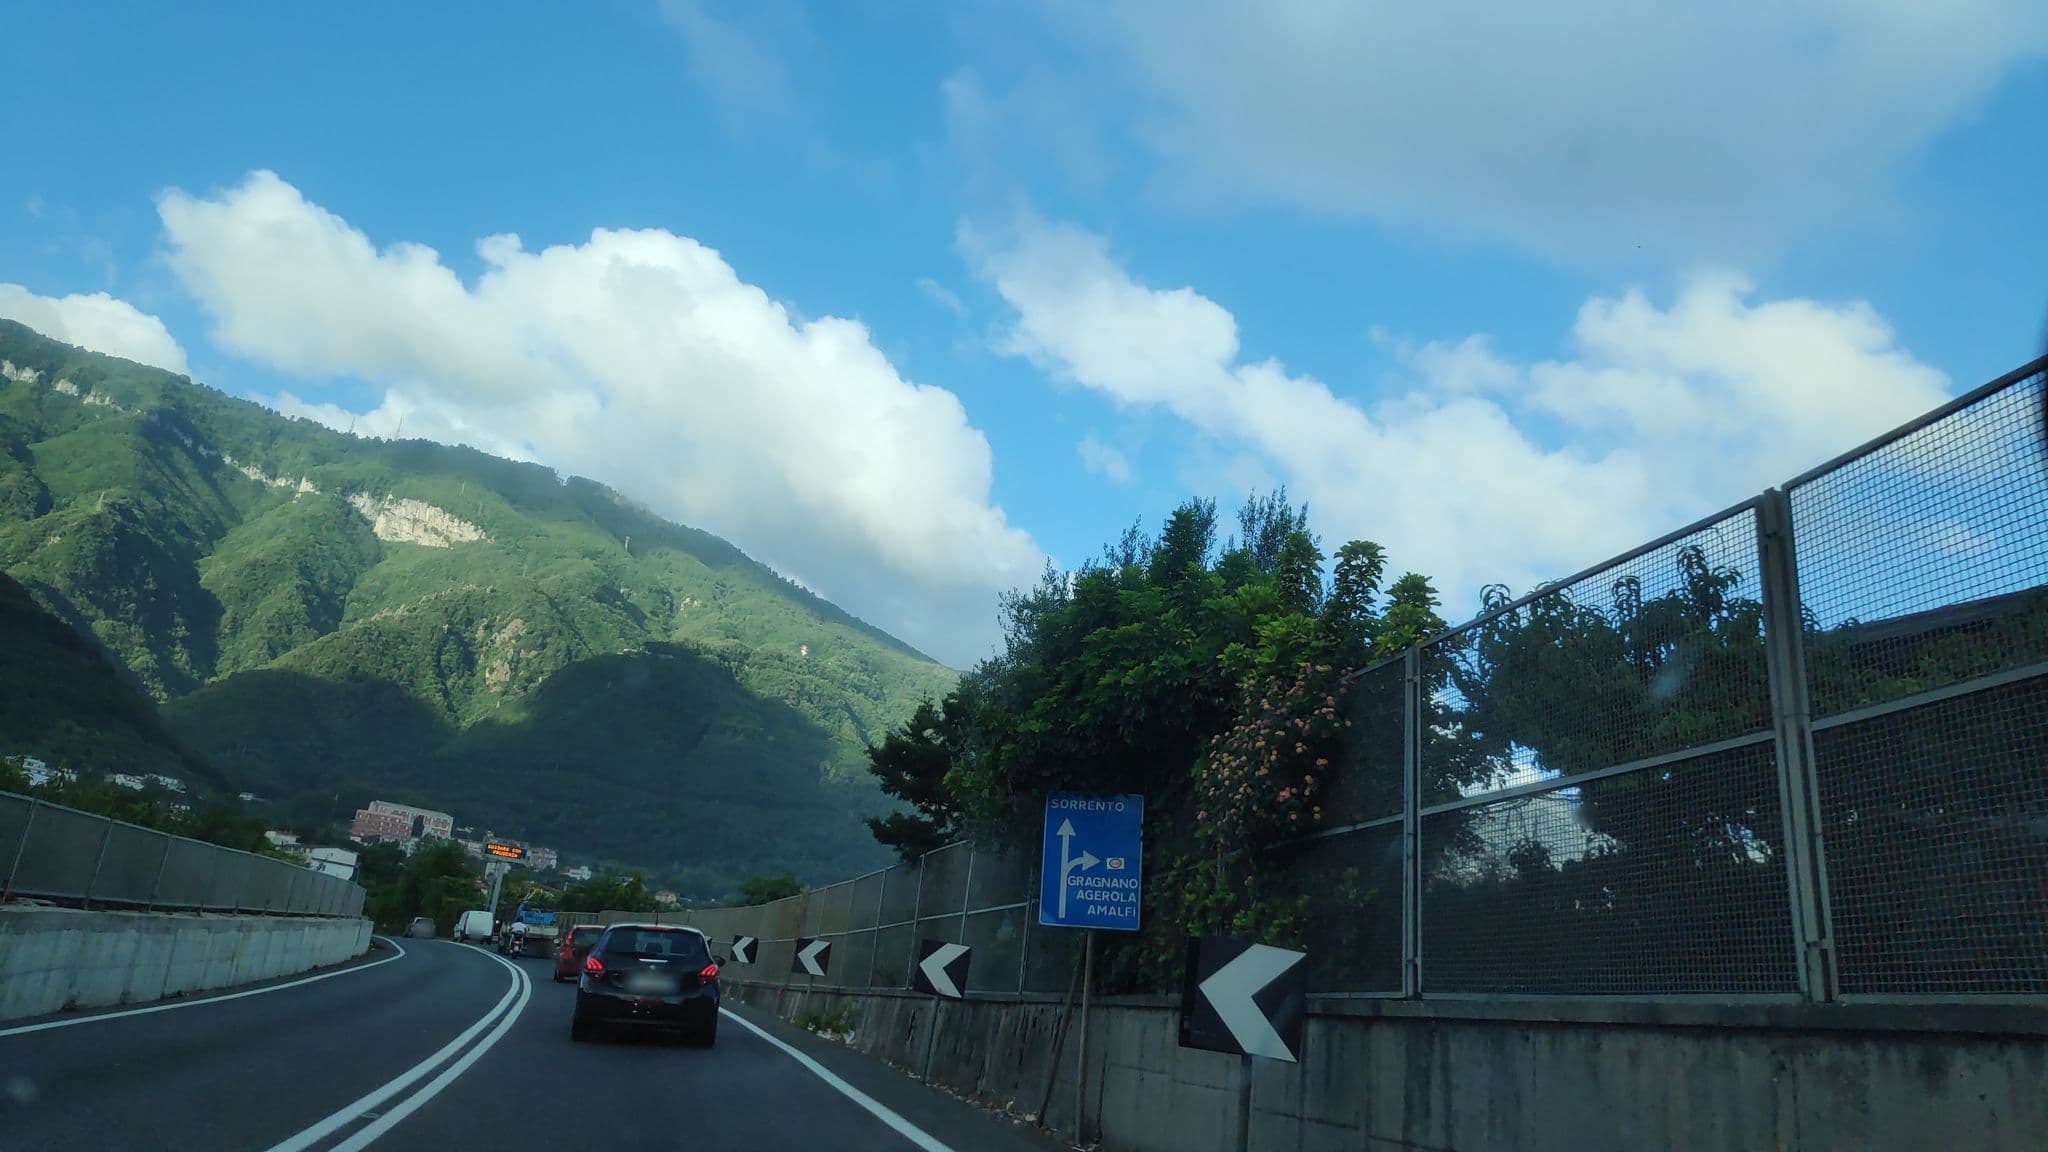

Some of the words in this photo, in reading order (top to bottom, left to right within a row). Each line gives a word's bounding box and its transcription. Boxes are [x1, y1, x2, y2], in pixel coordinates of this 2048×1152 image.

[1051, 799, 1125, 812] SORRENTO
[1067, 875, 1138, 889] GRAGNANO
[1076, 890, 1137, 903] AGEROLA
[1087, 905, 1136, 917] AMALFI
